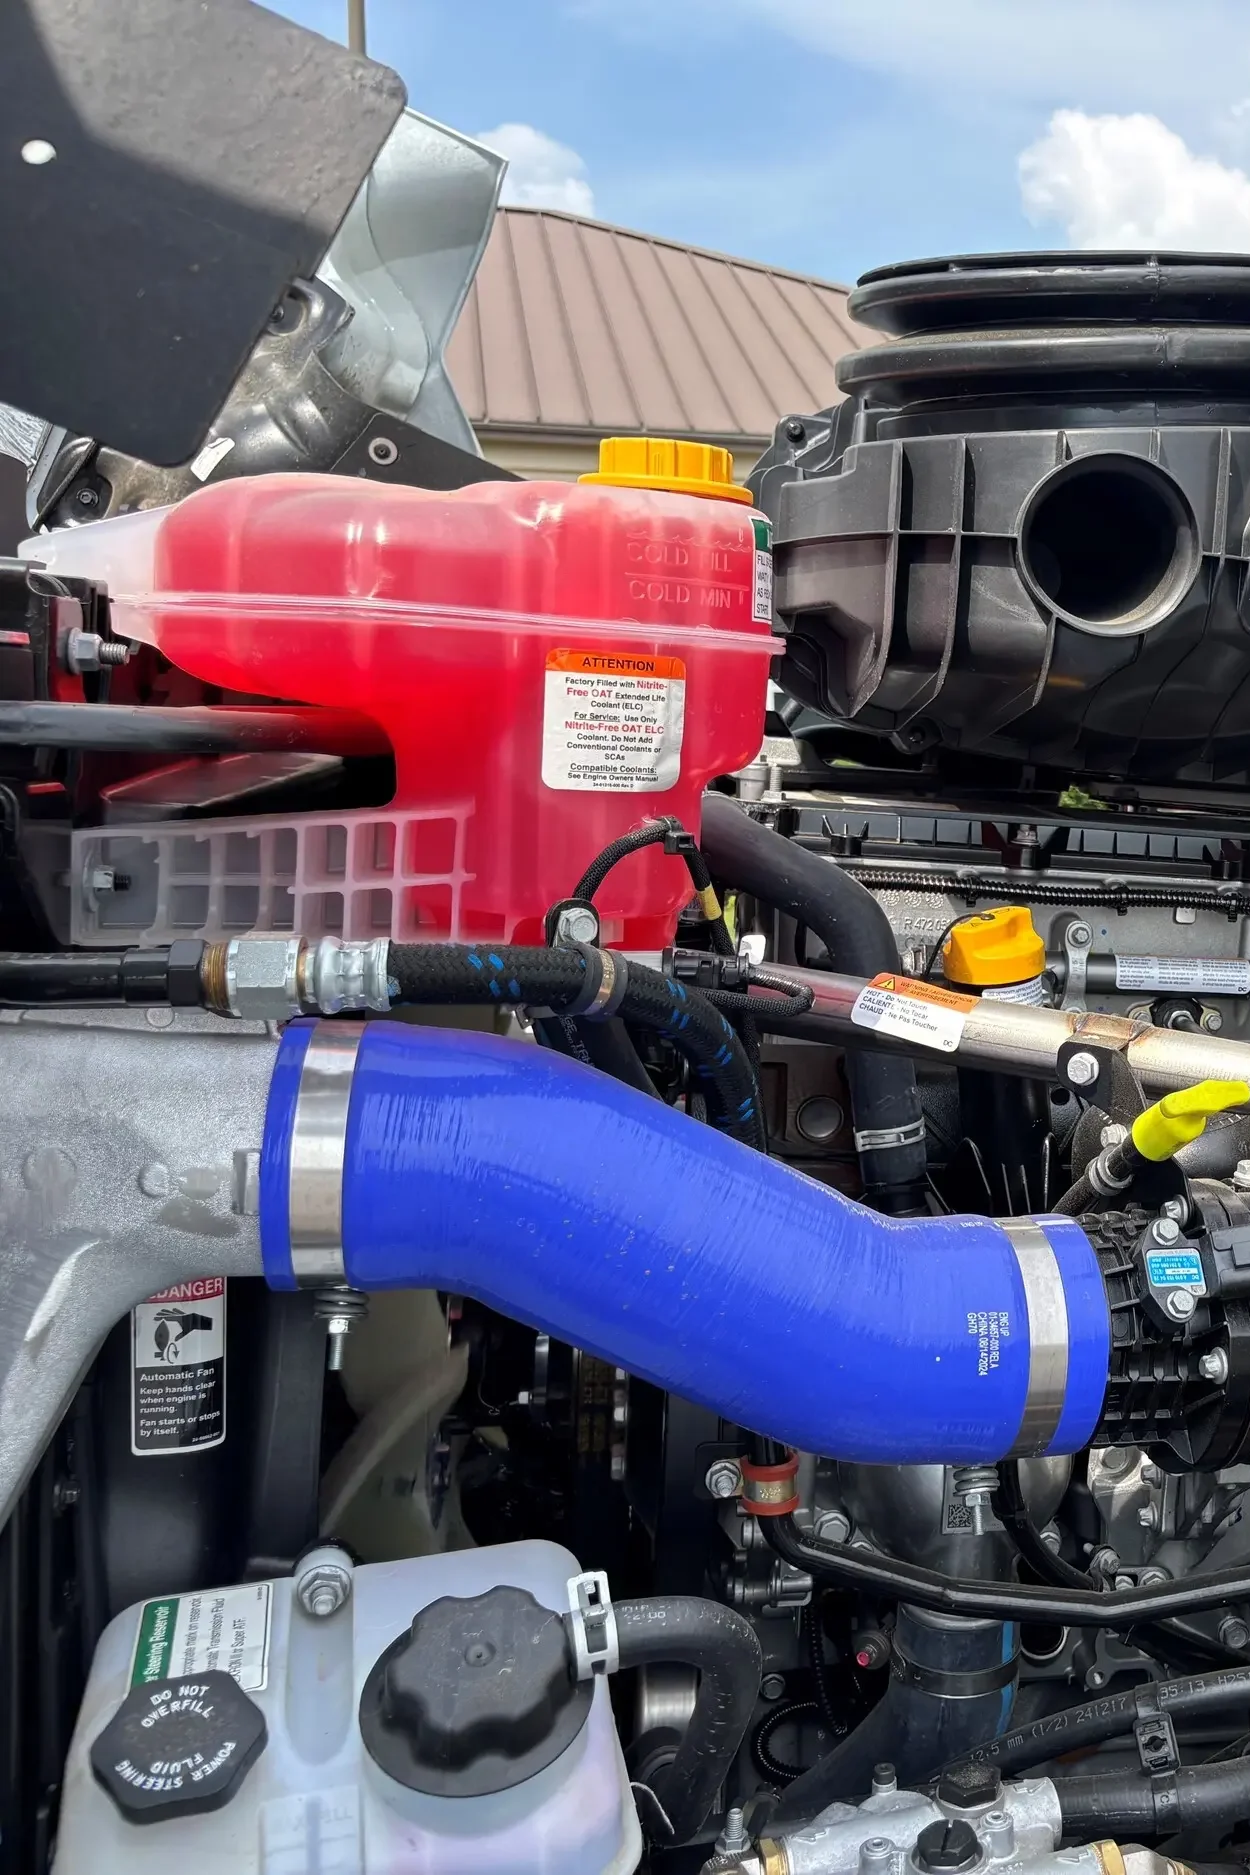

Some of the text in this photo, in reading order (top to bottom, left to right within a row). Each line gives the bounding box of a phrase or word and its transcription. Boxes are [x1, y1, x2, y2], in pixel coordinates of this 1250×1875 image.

[627, 542, 689, 565] COLD
[629, 580, 731, 608] COLD MIN
[582, 657, 655, 672] ATTENTION
[565, 677, 668, 690] Factory Filled with Nitrite-
[566, 688, 666, 702] Free OAT Extended Life
[590, 700, 644, 712] Coolant (ELC)
[574, 712, 658, 724] For Service: Use Only
[564, 720, 665, 734] Nitrite-Free OAT ELC
[576, 732, 609, 742] Coolant.
[611, 735, 622, 743] Do
[638, 736, 653, 744] Add
[566, 742, 618, 752] Conventional
[619, 744, 652, 753] Coolants
[604, 753, 626, 761] SCAs
[570, 762, 657, 774] Compatible Coolants:
[567, 772, 582, 780] See
[582, 774, 608, 782] Engine
[608, 774, 634, 782] Owners
[904, 918, 912, 929] R
[914, 917, 933, 931] 472
[866, 990, 880, 998] HOT
[886, 994, 894, 1002] Do
[897, 998, 907, 1006] Not
[862, 996, 895, 1010] CALIENTE
[900, 1006, 910, 1014] No
[911, 1008, 928, 1020] Tocar
[859, 1003, 884, 1015] CHAUD
[888, 1012, 898, 1020] Ne
[899, 1014, 910, 1024] Pas
[912, 1018, 938, 1032] Toucher
[942, 1040, 954, 1048] DC
[967, 1312, 978, 1334] GH70
[978, 1312, 988, 1336] CHINA
[999, 1312, 1010, 1336] ENG UP
[140, 1368, 215, 1382] Automatic Fan
[140, 1380, 216, 1396] Keep hands clear
[140, 1392, 206, 1404] when engine is
[140, 1405, 178, 1416] running.
[140, 1410, 220, 1427] Fan starts or stops
[140, 1426, 180, 1437] by itself.
[150, 1606, 170, 1643] Reservoir
[207, 1612, 224, 1651] Transmission
[143, 1640, 168, 1676] Steering
[150, 1685, 210, 1706] DO NOT
[141, 1699, 214, 1728] OVERFILL
[1007, 1734, 1024, 1749] mm
[114, 1742, 236, 1791] POWER STEERING
[150, 1752, 205, 1774] FLUID
